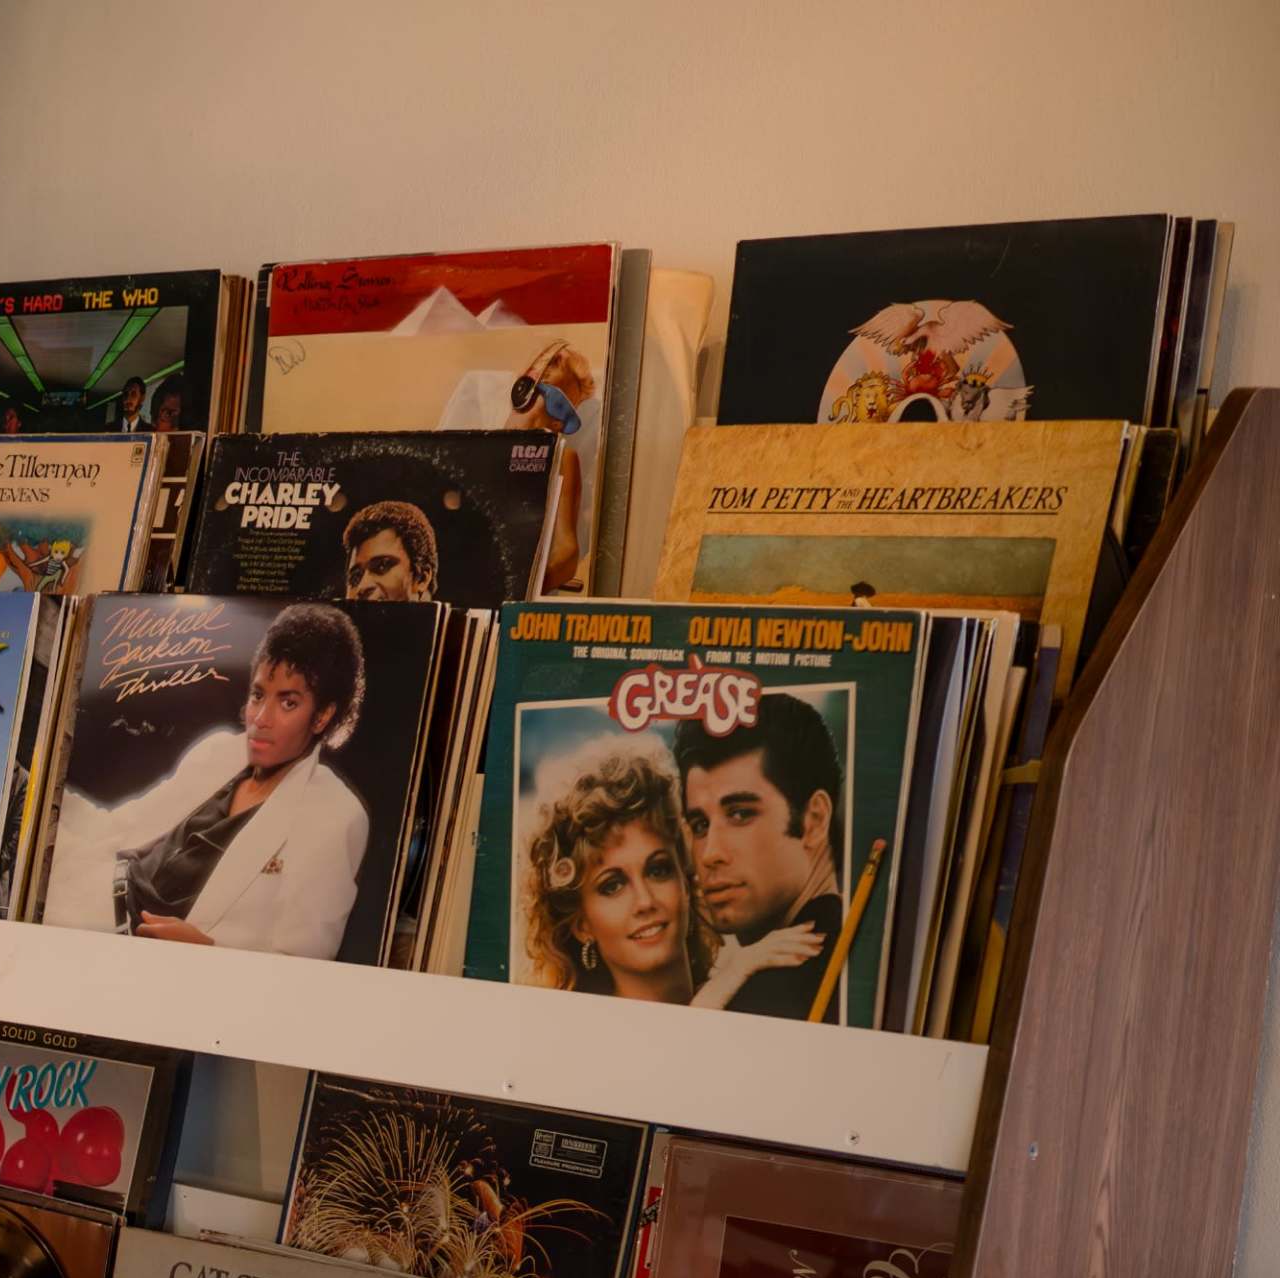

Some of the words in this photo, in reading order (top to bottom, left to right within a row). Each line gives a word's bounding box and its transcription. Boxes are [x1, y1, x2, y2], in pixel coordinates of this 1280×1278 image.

[23, 294, 64, 313] HARD
[82, 290, 113, 310] THE
[122, 287, 159, 307] WHO
[277, 451, 301, 467] THE
[512, 445, 549, 458] RCA
[5, 454, 101, 487] Tillerman
[235, 466, 336, 483] INCOMPARABLE
[224, 481, 341, 506] CHARLEY
[708, 487, 758, 510] TOM
[761, 488, 841, 510] PETTY
[855, 486, 1069, 512] HEARTBREAKERS
[240, 505, 313, 529] PRIDE
[101, 602, 232, 646] Michael
[510, 612, 560, 641] JOHN
[565, 614, 652, 644] TRAVOLTA
[689, 617, 752, 647] OLIVIA
[756, 617, 912, 653] NEWTON-JOHN
[100, 637, 232, 685] Jackson
[573, 647, 589, 658] THE
[590, 647, 628, 661] ORIGINAL
[705, 651, 731, 664] FROM
[735, 651, 752, 664] THE
[755, 652, 790, 666] MOTION
[794, 654, 831, 667] PICTURE
[115, 664, 230, 703] Thriller
[616, 671, 758, 734] GREASE
[1, 1025, 37, 1042] SOLID
[43, 1032, 77, 1049] GOLD
[9, 1059, 97, 1113] ROCK
